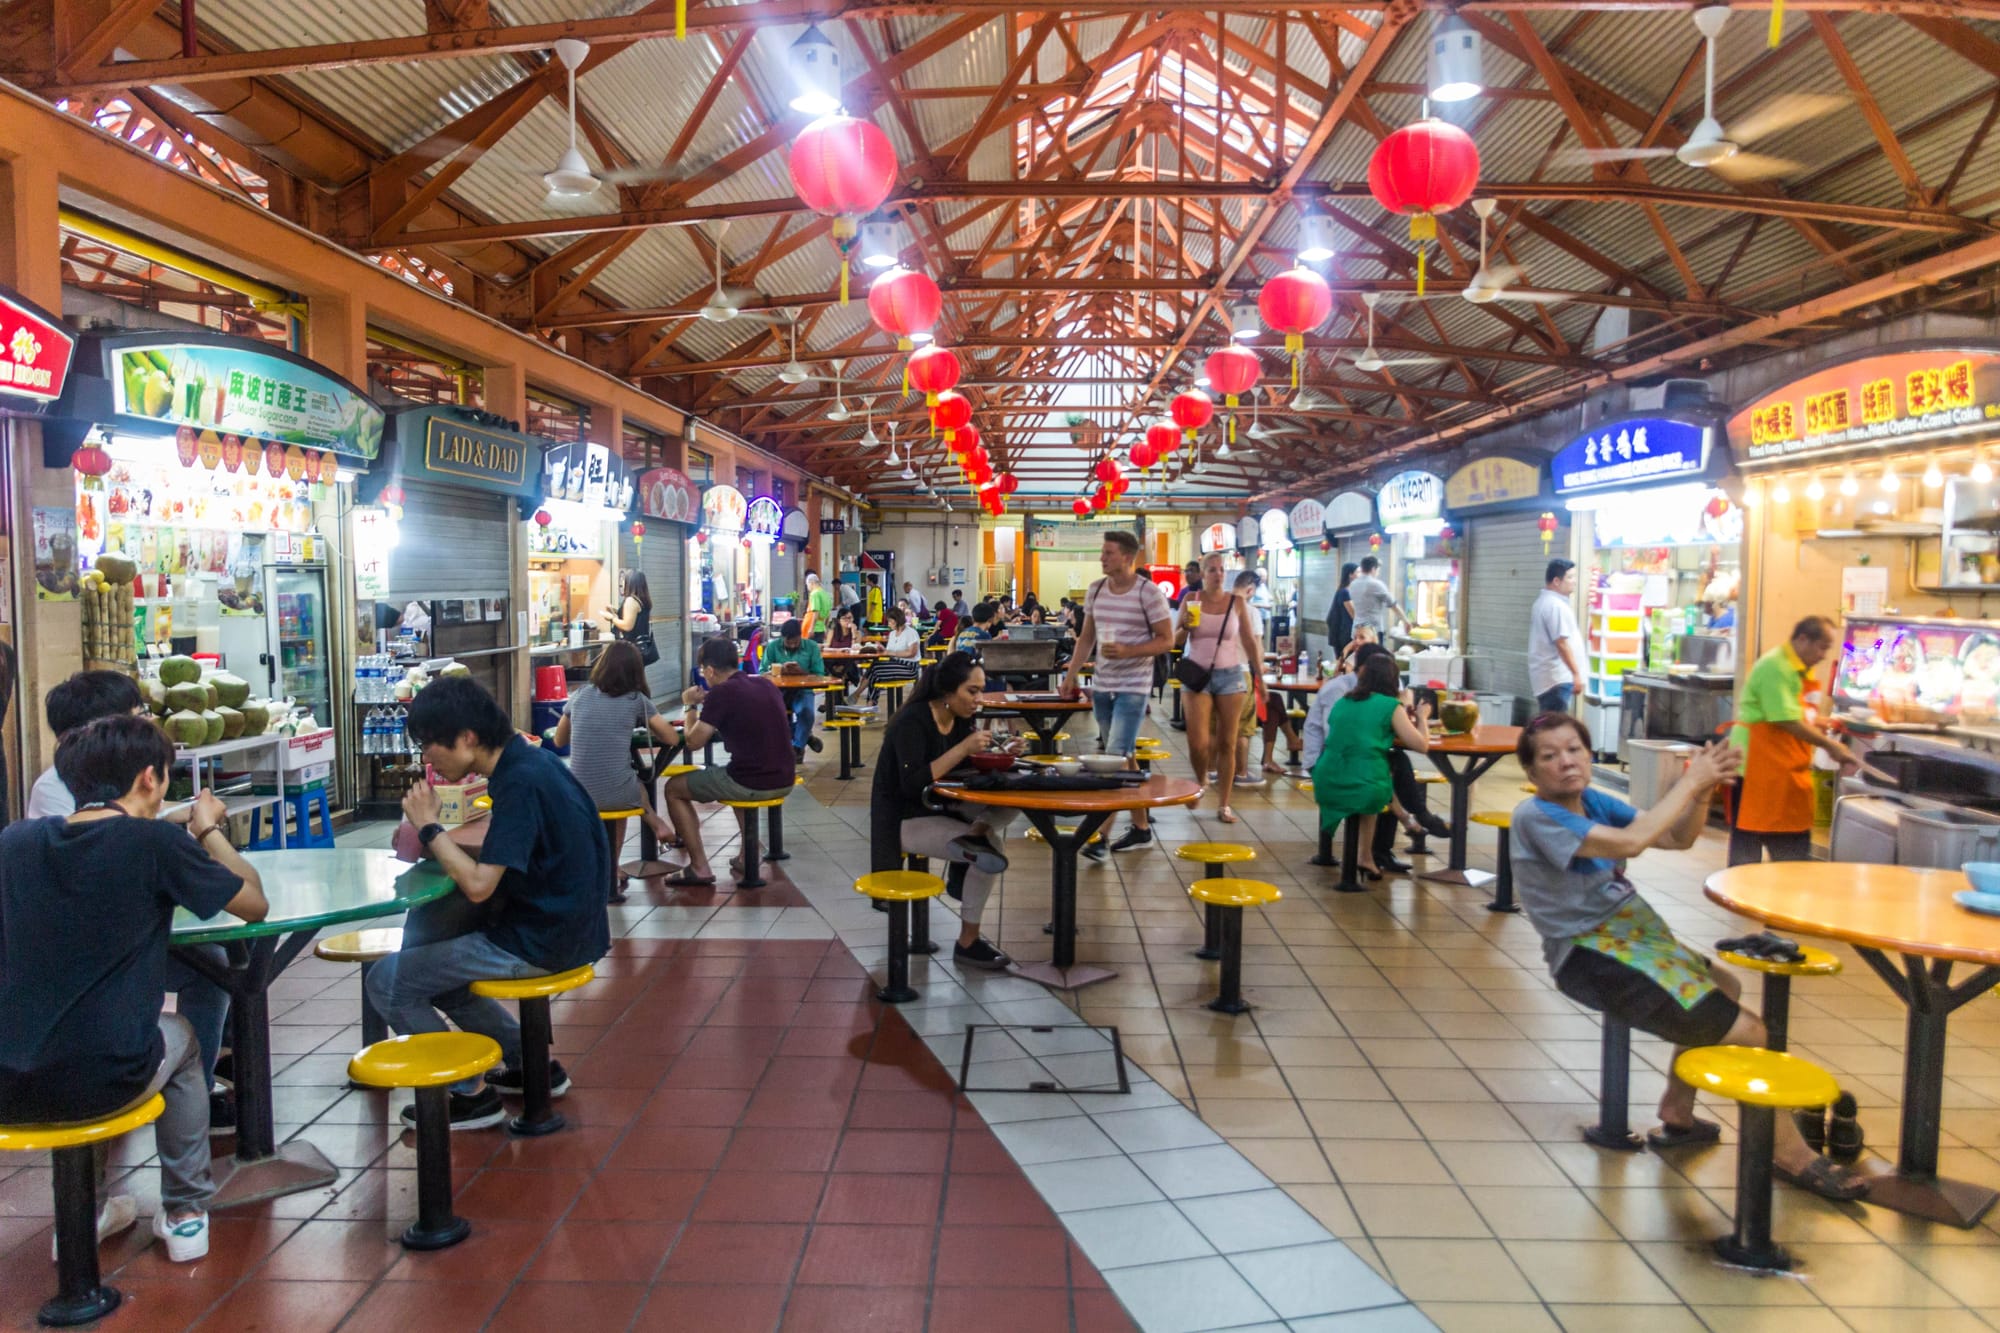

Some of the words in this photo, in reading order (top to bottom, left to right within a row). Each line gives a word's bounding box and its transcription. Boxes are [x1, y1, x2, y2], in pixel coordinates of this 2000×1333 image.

[13, 364, 52, 388] HOON
[229, 370, 308, 413] 麻坡甘蔗王
[238, 402, 256, 414] Muar
[259, 407, 298, 426] Sugarcane
[1889, 417, 1917, 435] Oyster
[1921, 410, 1952, 428] Carrot
[1952, 406, 1982, 424] Cake
[439, 431, 472, 464] LAD
[474, 440, 486, 468] &
[489, 443, 518, 473] DAD
[1408, 476, 1433, 503] FARM
